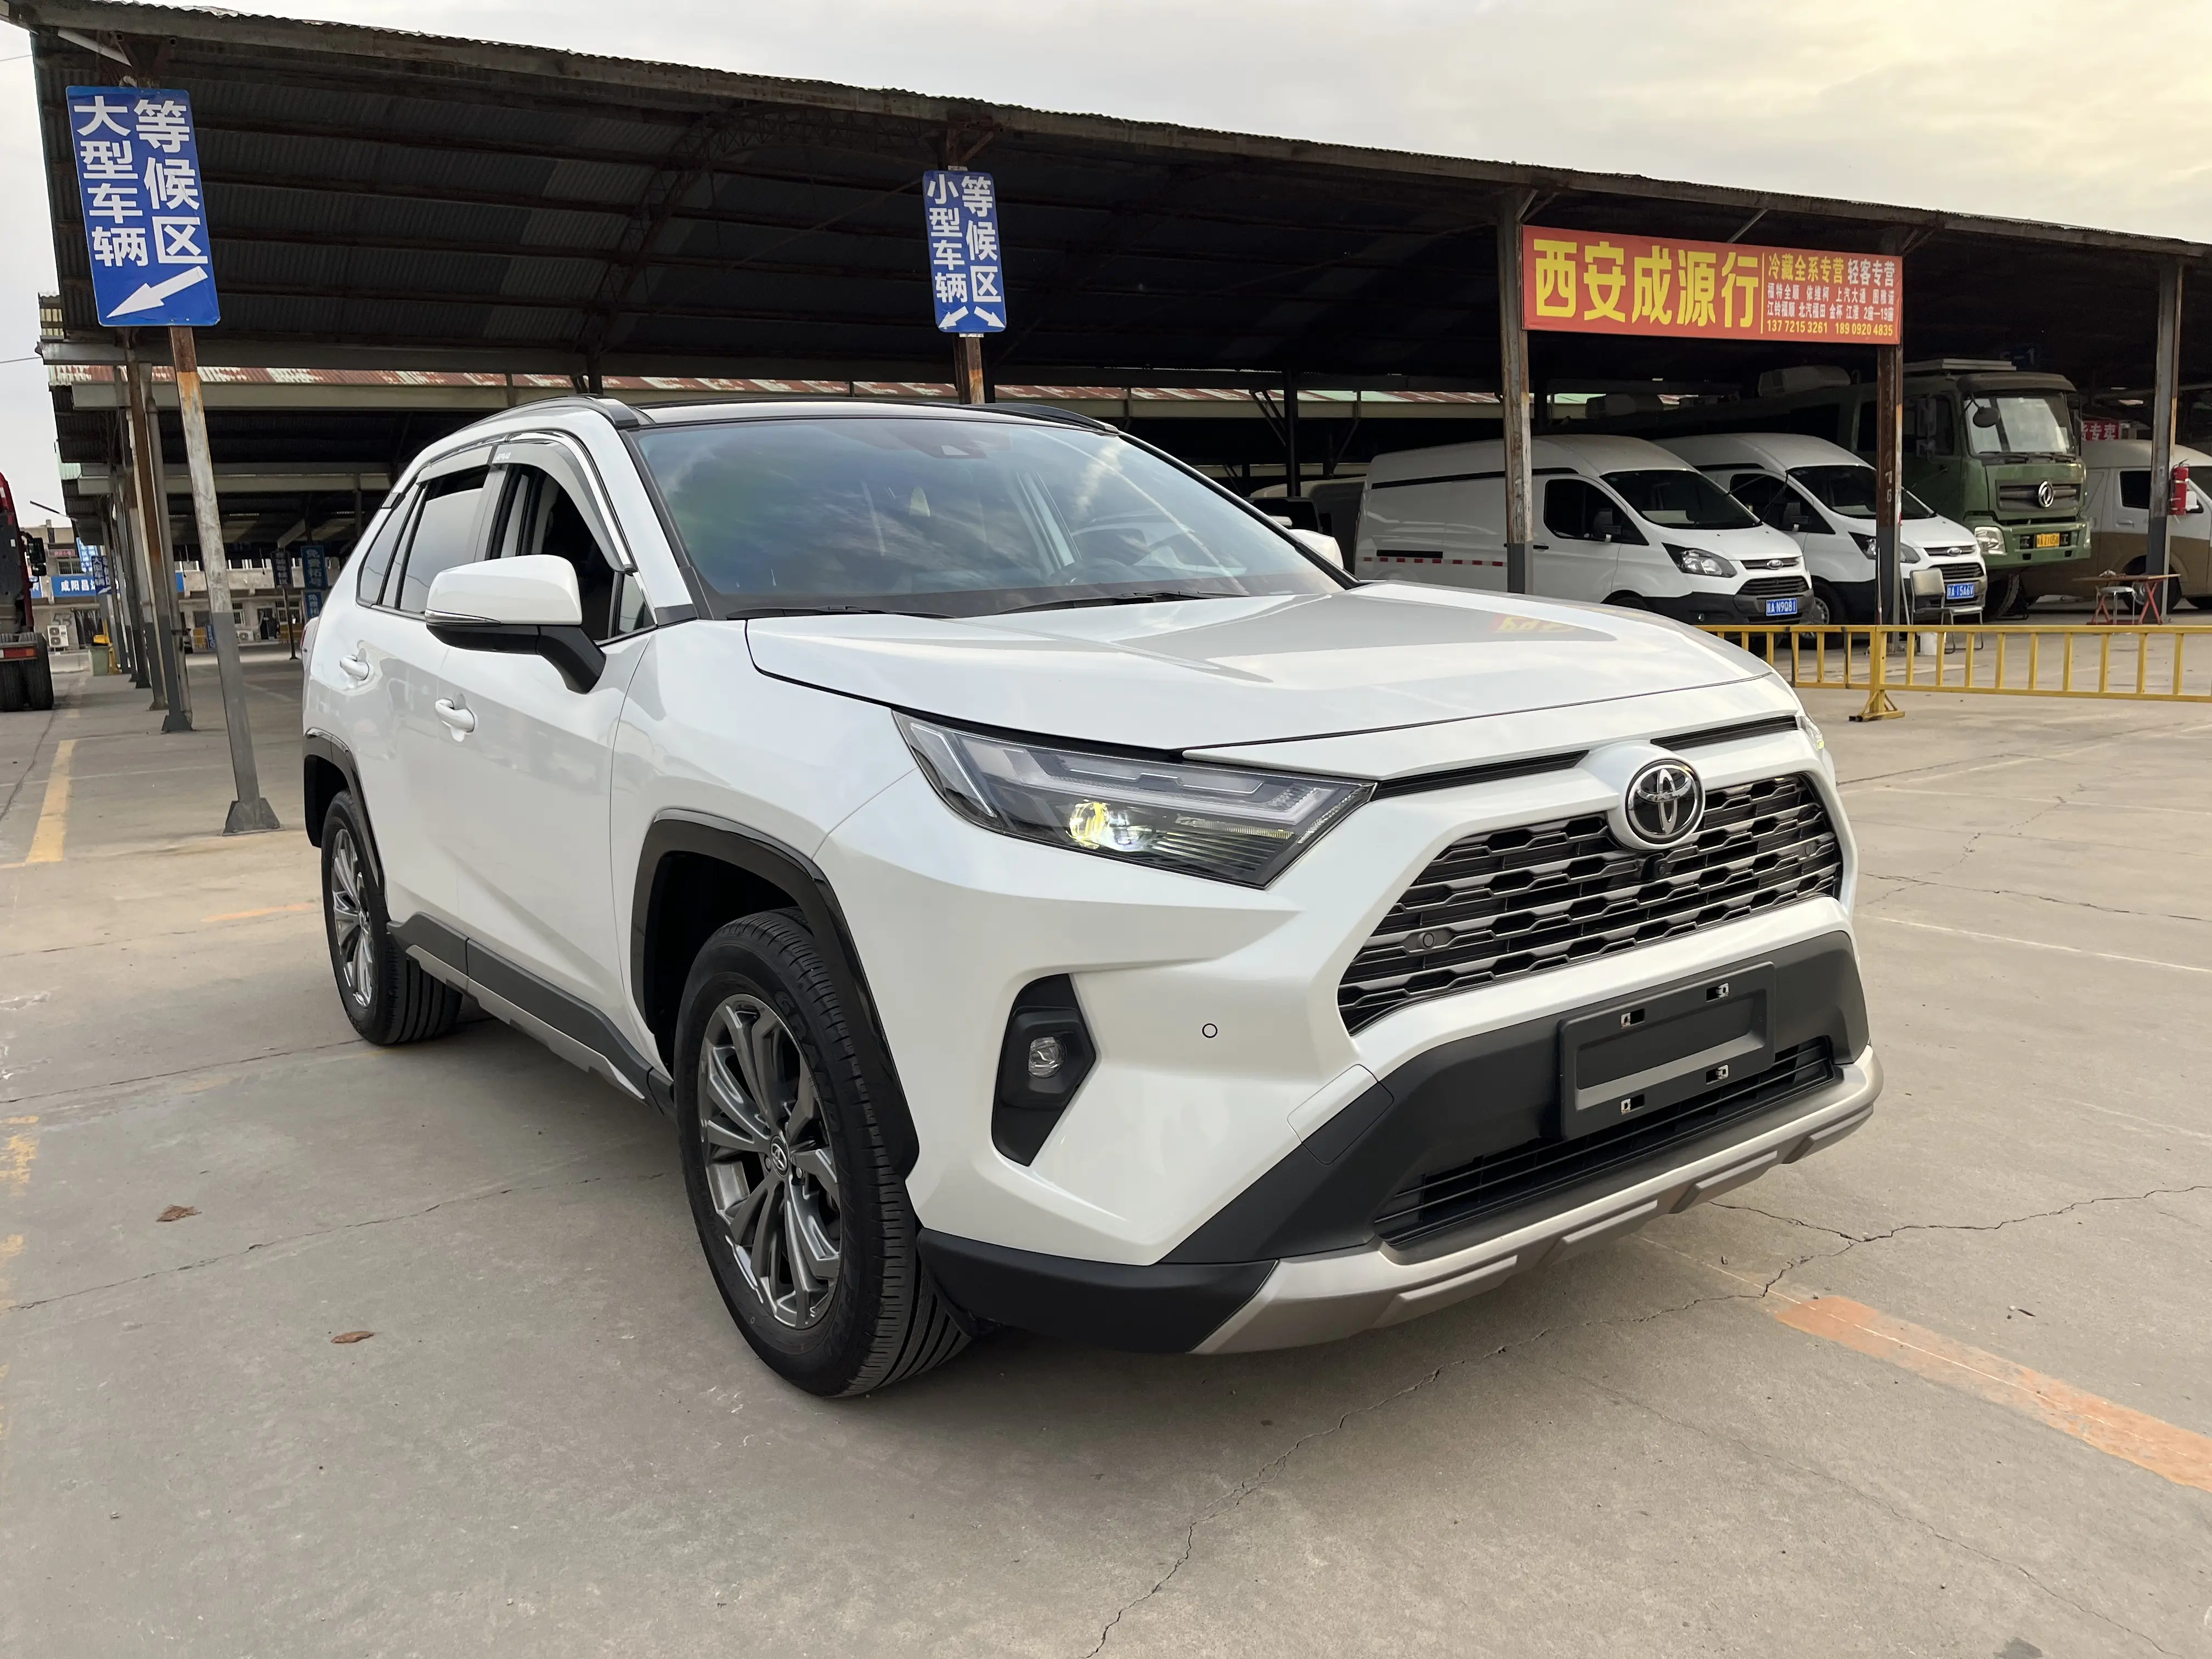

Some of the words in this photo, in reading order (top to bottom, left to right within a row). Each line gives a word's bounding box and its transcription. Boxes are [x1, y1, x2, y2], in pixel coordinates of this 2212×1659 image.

[74, 95, 149, 267] 大型车辆
[134, 99, 208, 264] 等候区
[927, 173, 968, 303] 小型车辆
[961, 176, 1002, 302] 等候区
[1533, 239, 1759, 328] 西安成源行
[1767, 319, 1782, 332] 137
[1785, 320, 1805, 333] 7215
[1808, 321, 1828, 334] 3261
[1835, 322, 1850, 335] 189
[1852, 323, 1871, 335] 0920
[1873, 324, 1893, 336] 4835
[1768, 252, 1844, 284] 冷藏全系专营
[1847, 258, 1895, 287] 轻客专营
